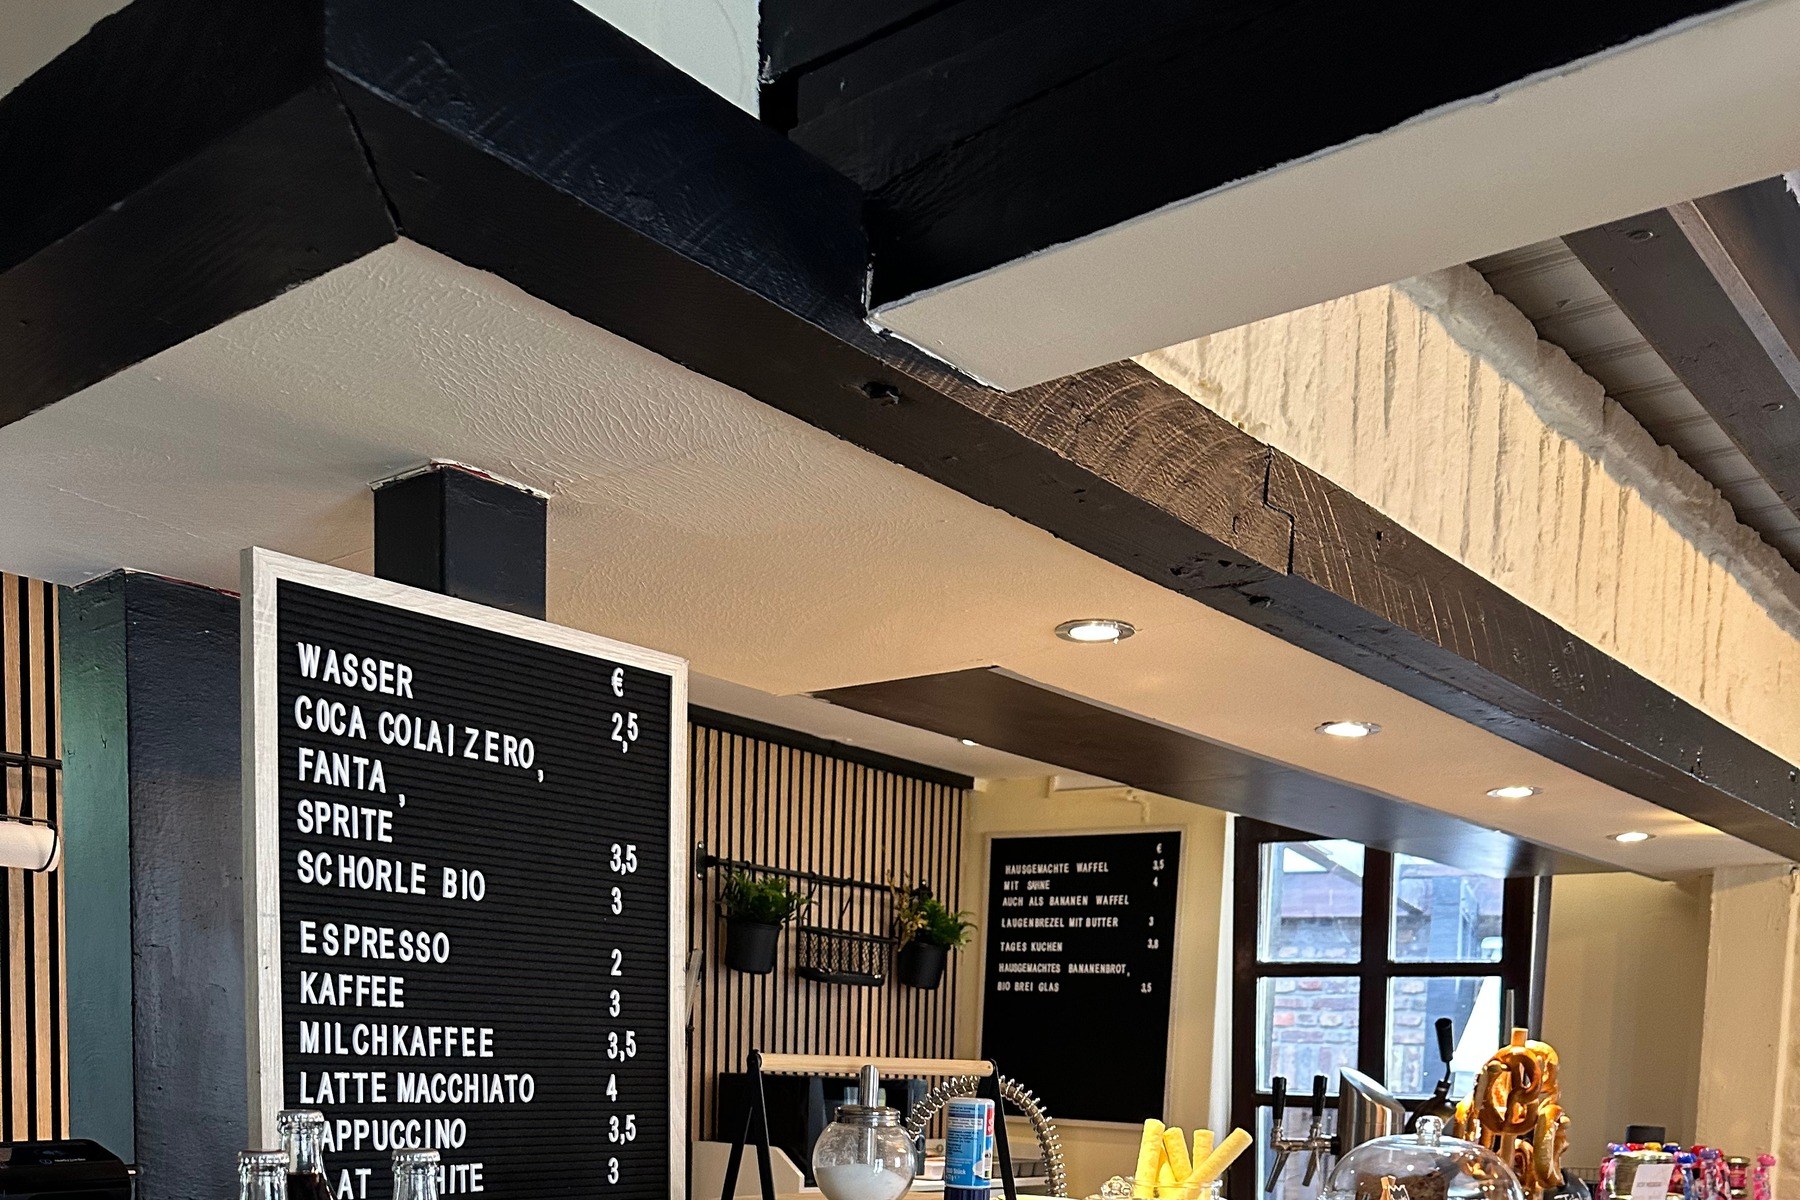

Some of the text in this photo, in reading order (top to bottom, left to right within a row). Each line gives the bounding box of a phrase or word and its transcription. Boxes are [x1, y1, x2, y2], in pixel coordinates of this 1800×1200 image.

[296, 641, 639, 754] WASSER 2,5
[611, 667, 625, 698] €
[294, 695, 367, 740] COCA
[296, 798, 638, 876] SPRITE 3,5
[297, 849, 623, 915] SCHORLE BIO 3
[1003, 880, 1020, 891] MIT
[1152, 876, 1159, 888] 4
[1005, 862, 1070, 875] HAUSGEMACHTE
[1076, 861, 1109, 873] WAFFEL
[1002, 894, 1130, 907] AUCH ALS BANANEN WAFFEL
[1001, 916, 1154, 928] LAUGENBREZEL MIT BUTTER 3
[300, 920, 622, 977] ESPRESSO 2
[1000, 941, 1028, 953] TAGES
[1030, 941, 1063, 952] KUCHEN
[998, 962, 1061, 974] HAUSGEMACHTES
[300, 971, 621, 1018] KAFFEE 3
[997, 981, 1011, 991] BIO
[1014, 981, 1034, 992] BREI
[1038, 981, 1060, 993] GLAS
[300, 1020, 637, 1062] MILCHKAFFEE 3,5
[300, 1071, 618, 1105] LATTE MACCHIATO 4
[322, 1113, 637, 1153] APPUCCINO 3,5
[336, 1157, 619, 1200] AT HITE 3
